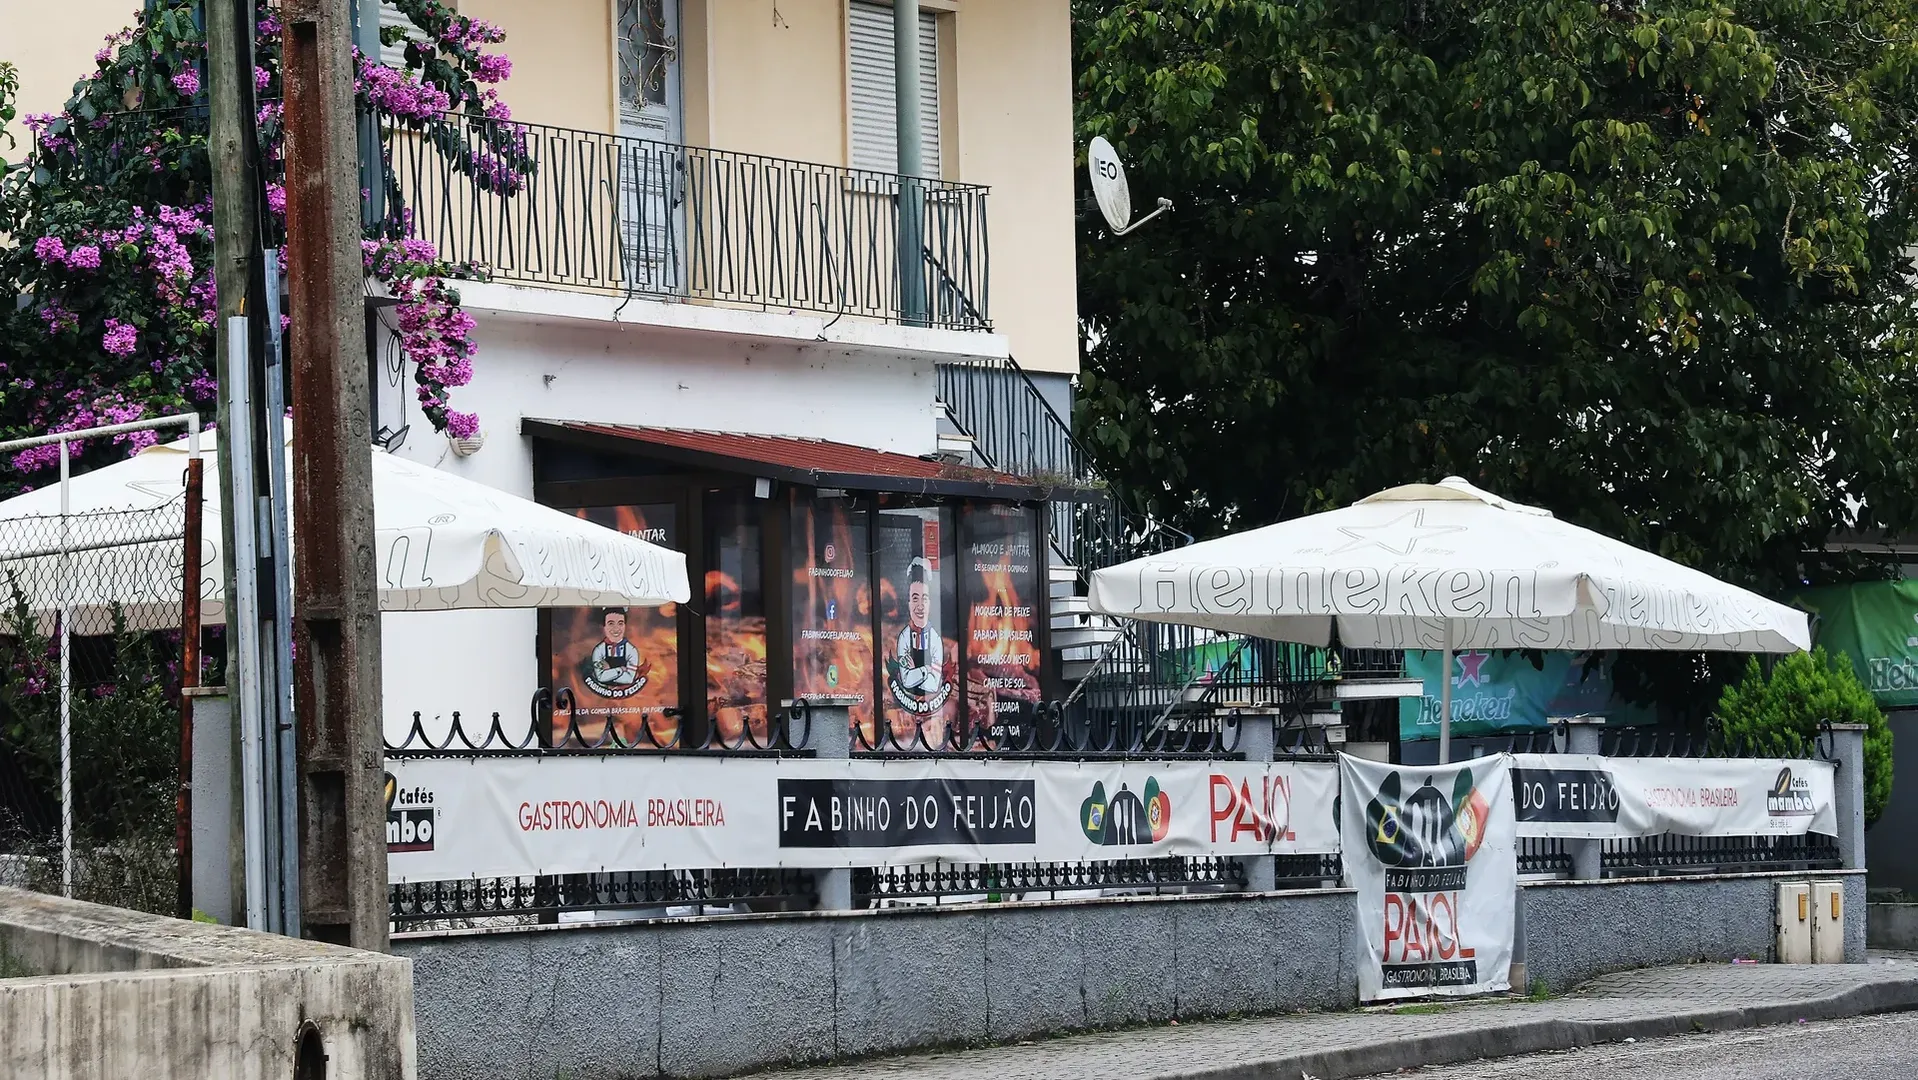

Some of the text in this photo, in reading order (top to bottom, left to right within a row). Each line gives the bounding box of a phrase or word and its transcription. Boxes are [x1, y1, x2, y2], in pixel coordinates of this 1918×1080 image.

[1000, 543, 1004, 555] E
[1134, 560, 1542, 618] Heineken
[974, 605, 1031, 618] MOQUECA DE PEIXE
[1004, 678, 1013, 688] DE
[1013, 678, 1026, 688] SOL
[890, 680, 918, 711] FABINHO
[918, 702, 929, 713] DO
[991, 701, 1020, 713] FEIJOADA
[399, 787, 434, 804] Cafés
[1522, 777, 1619, 810] DO FEIJÃO
[1768, 791, 1813, 811] mambo
[518, 798, 726, 832] GASTRONOMIA BRASILEIRA
[782, 788, 1033, 832] FABINHO DO FEIJÃO
[1385, 873, 1425, 888] FABINHO
[1428, 873, 1439, 887] DO
[1382, 891, 1476, 963] PAIOL
